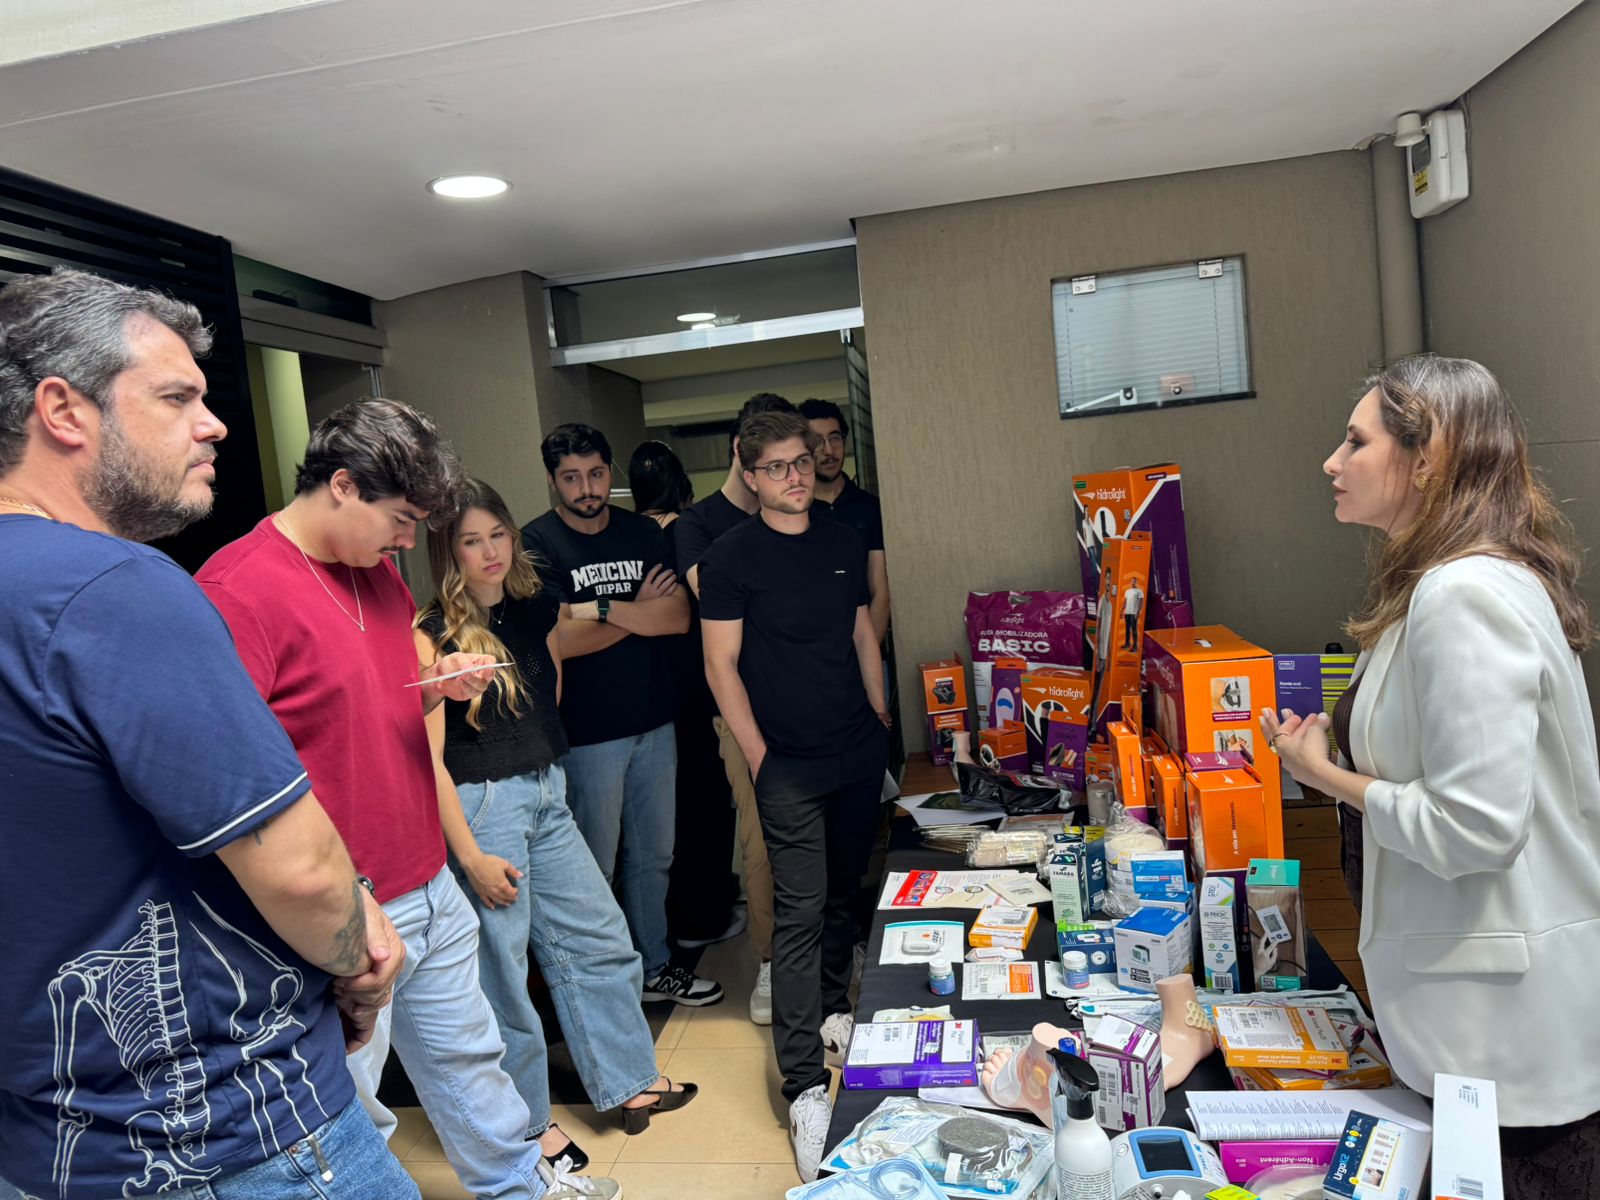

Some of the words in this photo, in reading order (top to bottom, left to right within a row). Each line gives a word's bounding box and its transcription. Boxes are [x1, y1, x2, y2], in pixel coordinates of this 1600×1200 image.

[1096, 487, 1126, 502] hidrolight
[571, 560, 643, 592] MEICIN
[594, 582, 632, 596] UPAR
[978, 638, 1051, 654] BASIC
[1049, 686, 1084, 700] hidrolight
